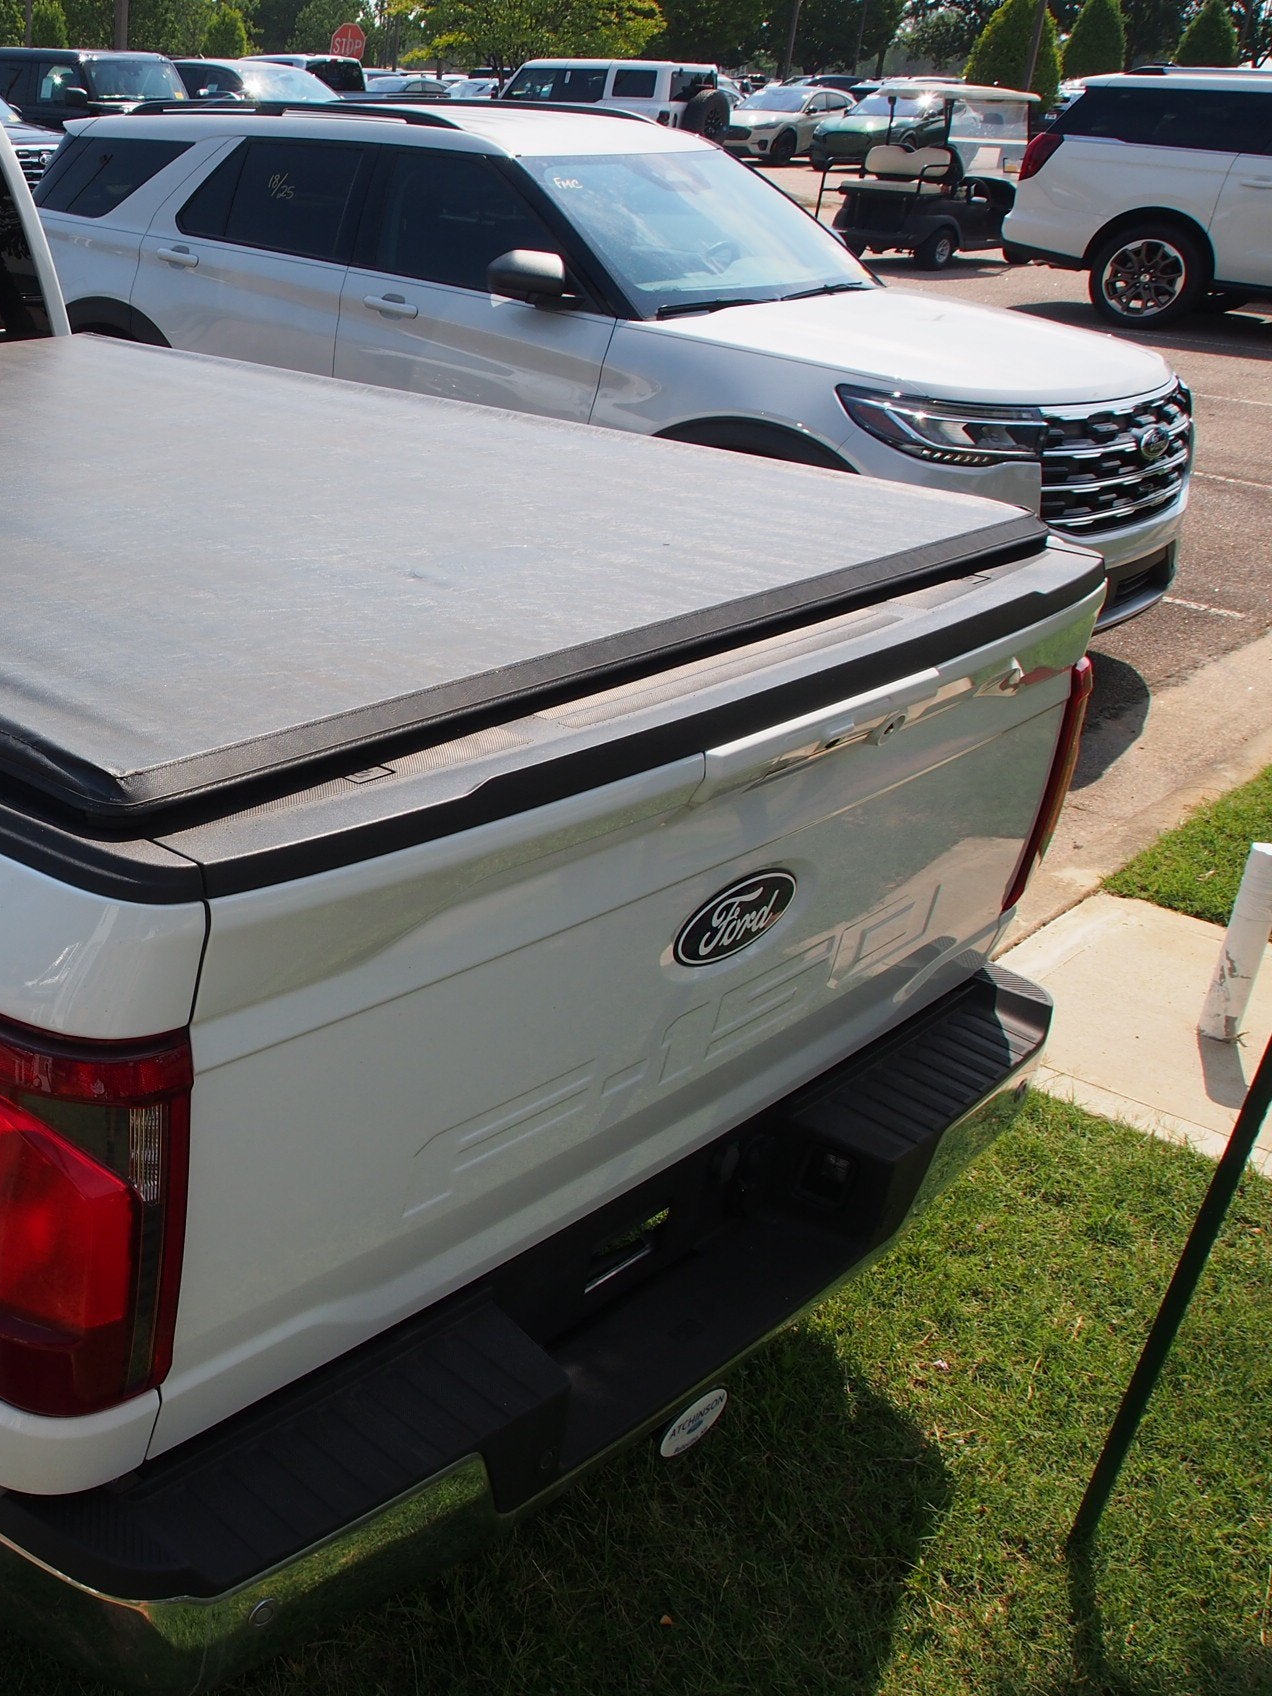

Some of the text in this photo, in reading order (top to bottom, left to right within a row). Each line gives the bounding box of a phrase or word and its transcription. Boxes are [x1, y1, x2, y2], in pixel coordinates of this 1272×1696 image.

[332, 37, 363, 56] STOP
[553, 176, 584, 189] FMC
[698, 886, 780, 956] Ford
[668, 1391, 726, 1441] ATCHINSON
